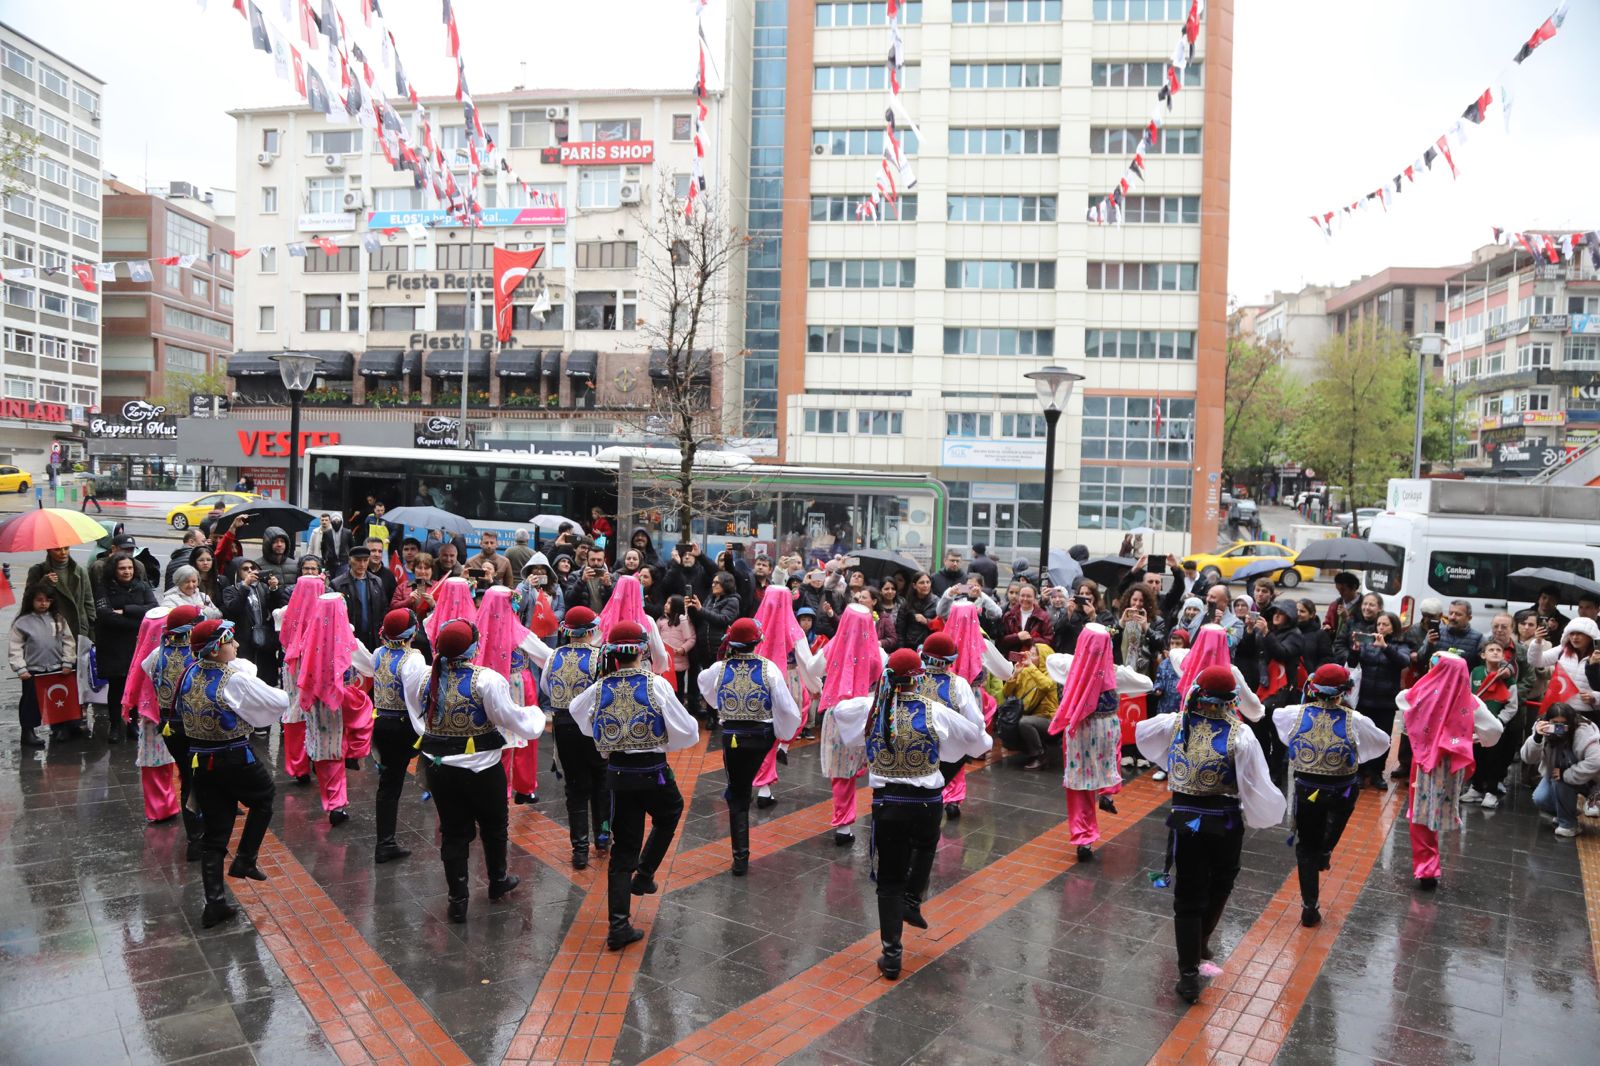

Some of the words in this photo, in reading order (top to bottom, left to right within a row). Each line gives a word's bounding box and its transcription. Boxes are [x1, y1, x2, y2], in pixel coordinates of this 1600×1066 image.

[561, 144, 606, 160] PARİS
[610, 145, 652, 159] SHOP
[444, 272, 544, 289] Restant
[91, 419, 142, 438] Kayseri
[147, 421, 177, 437] Mut
[416, 436, 443, 447] Kayseri
